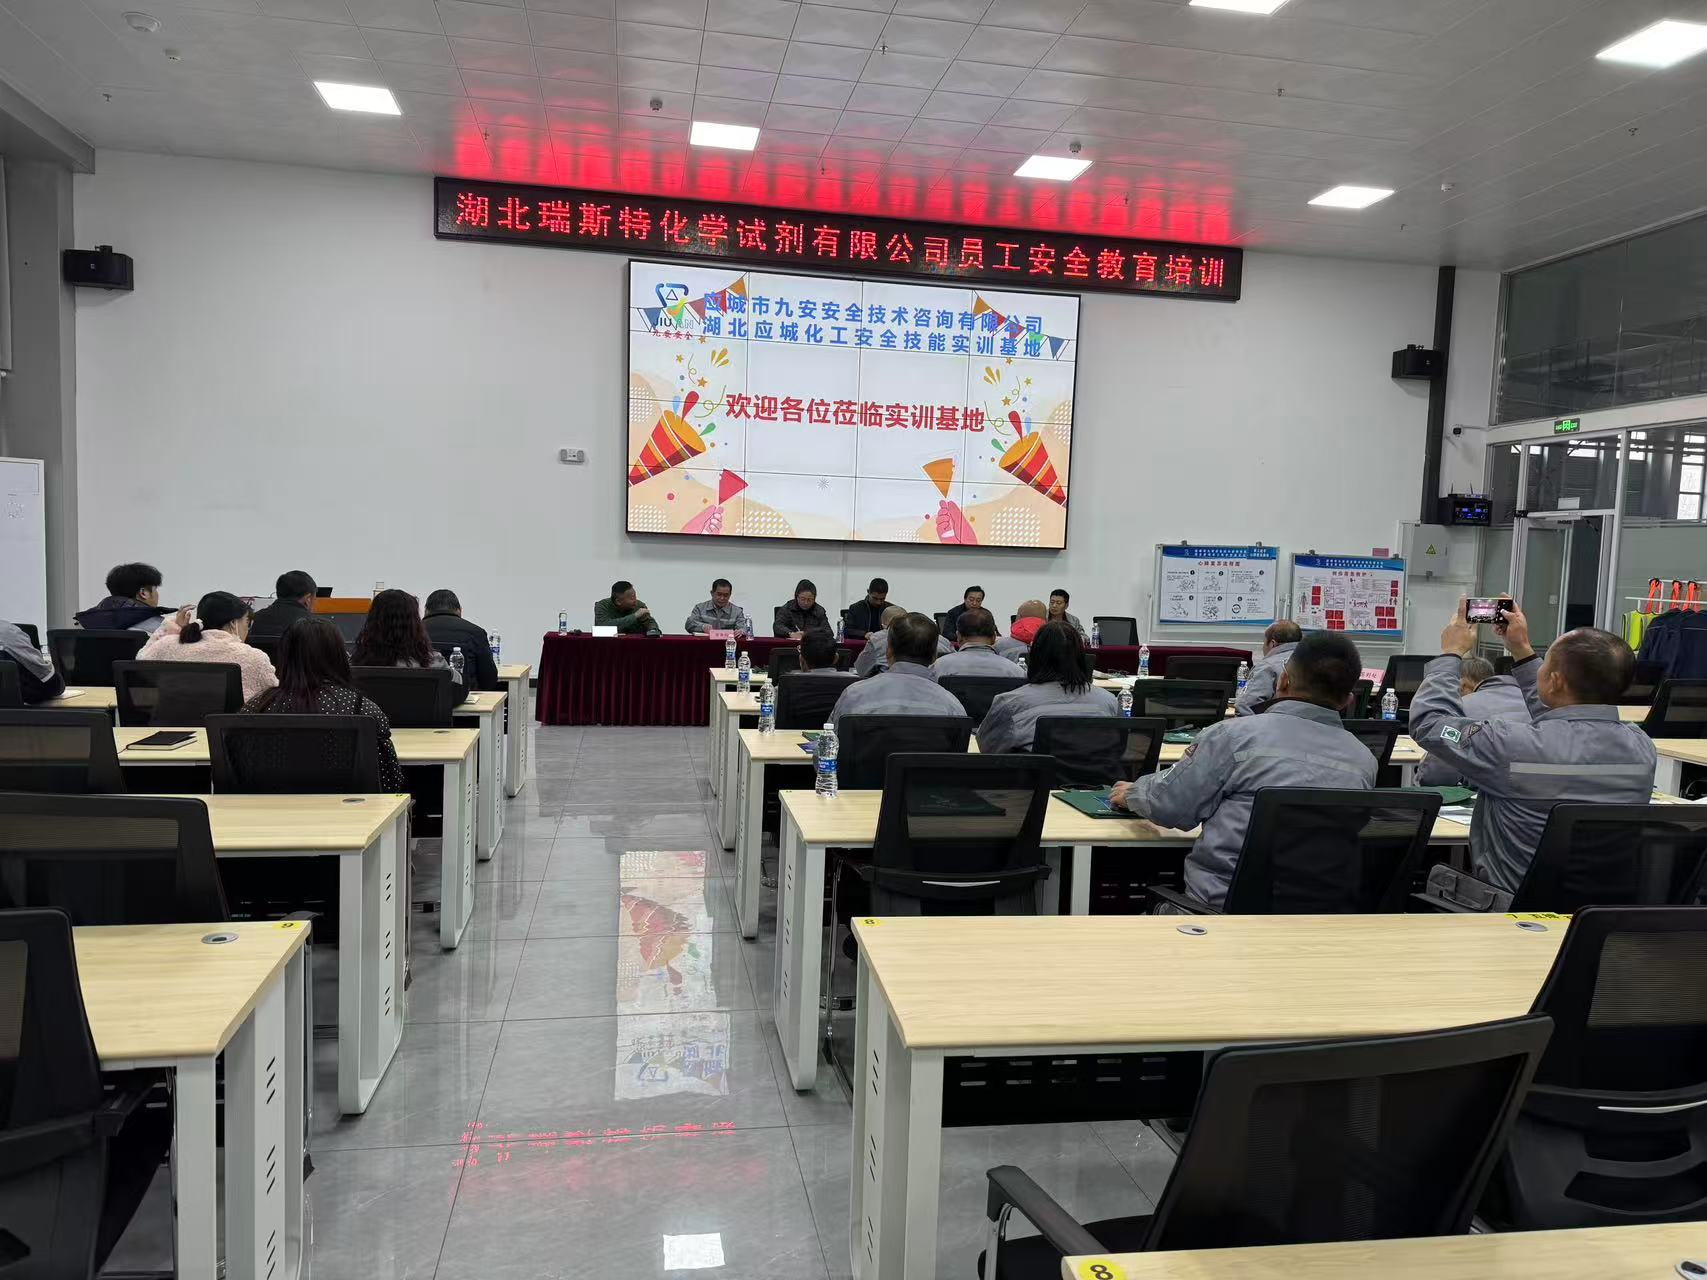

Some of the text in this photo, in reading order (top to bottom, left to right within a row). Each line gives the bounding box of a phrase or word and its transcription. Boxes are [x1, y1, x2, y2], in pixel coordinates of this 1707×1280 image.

[455, 191, 1225, 288] 湖北瑞斯特化学试剂有限公司员工安全教育培训
[703, 291, 1042, 335] 应城市九安安全技术咨询有限公司
[702, 315, 1041, 358] 湖北应城化工安全技能实训基地
[725, 392, 986, 433] 欢迎各位莅临实训基地
[1090, 1264, 1114, 1280] 8
